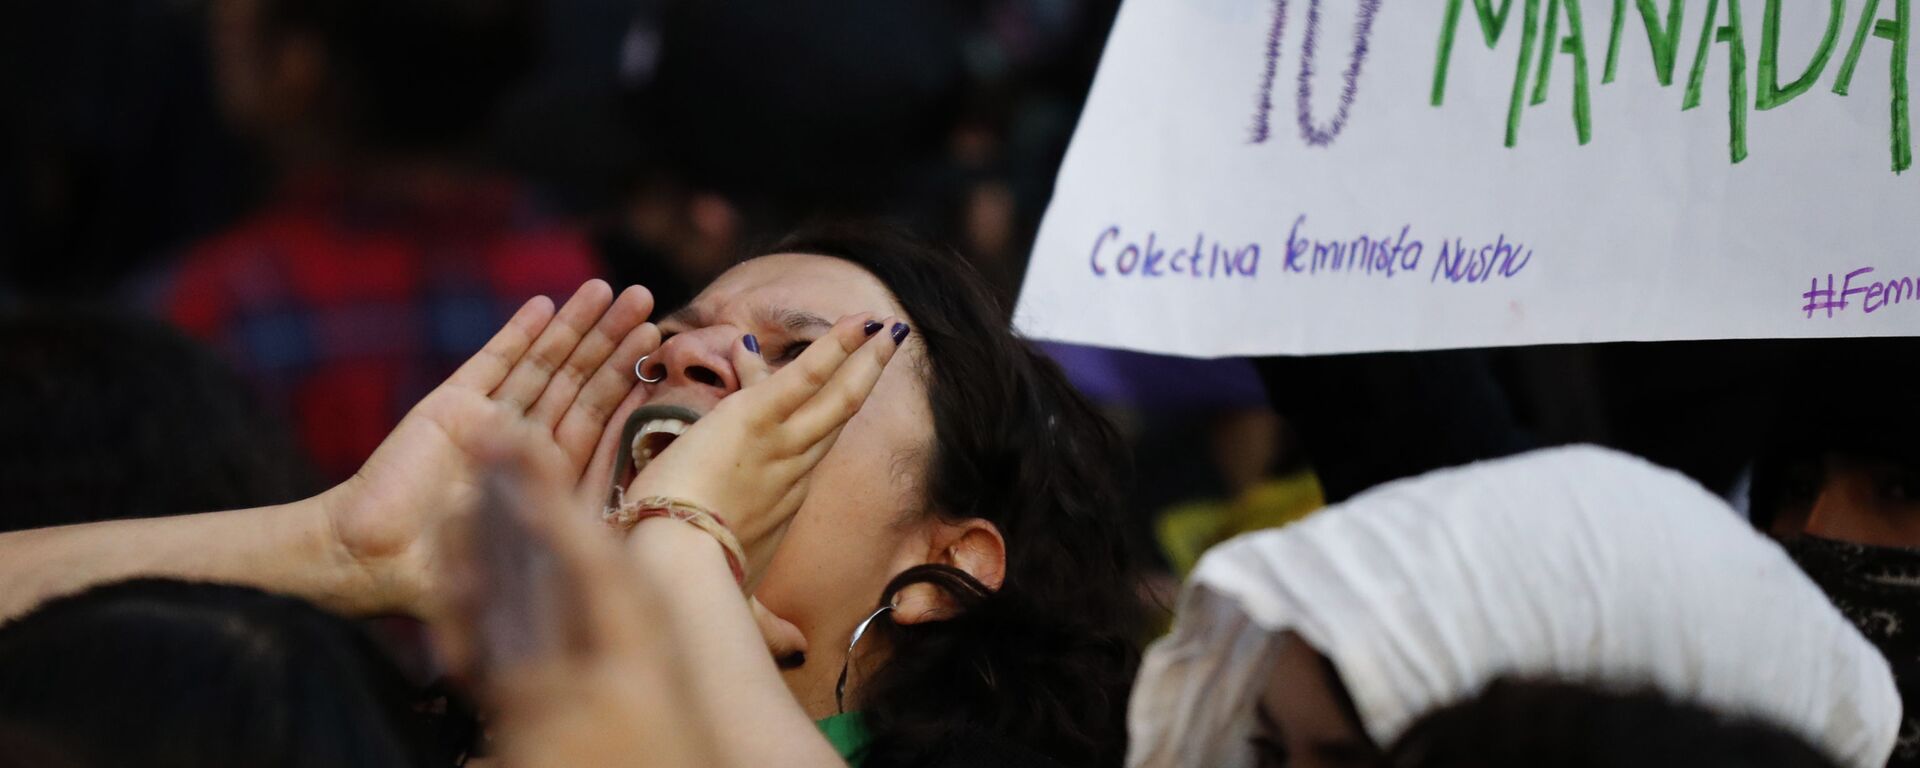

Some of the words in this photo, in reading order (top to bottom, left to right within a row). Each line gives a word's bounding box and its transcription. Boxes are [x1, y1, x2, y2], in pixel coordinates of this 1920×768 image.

[1430, 0, 1912, 174] MANADA
[1090, 225, 1261, 278] Colectiva
[1283, 213, 1423, 278] feminista
